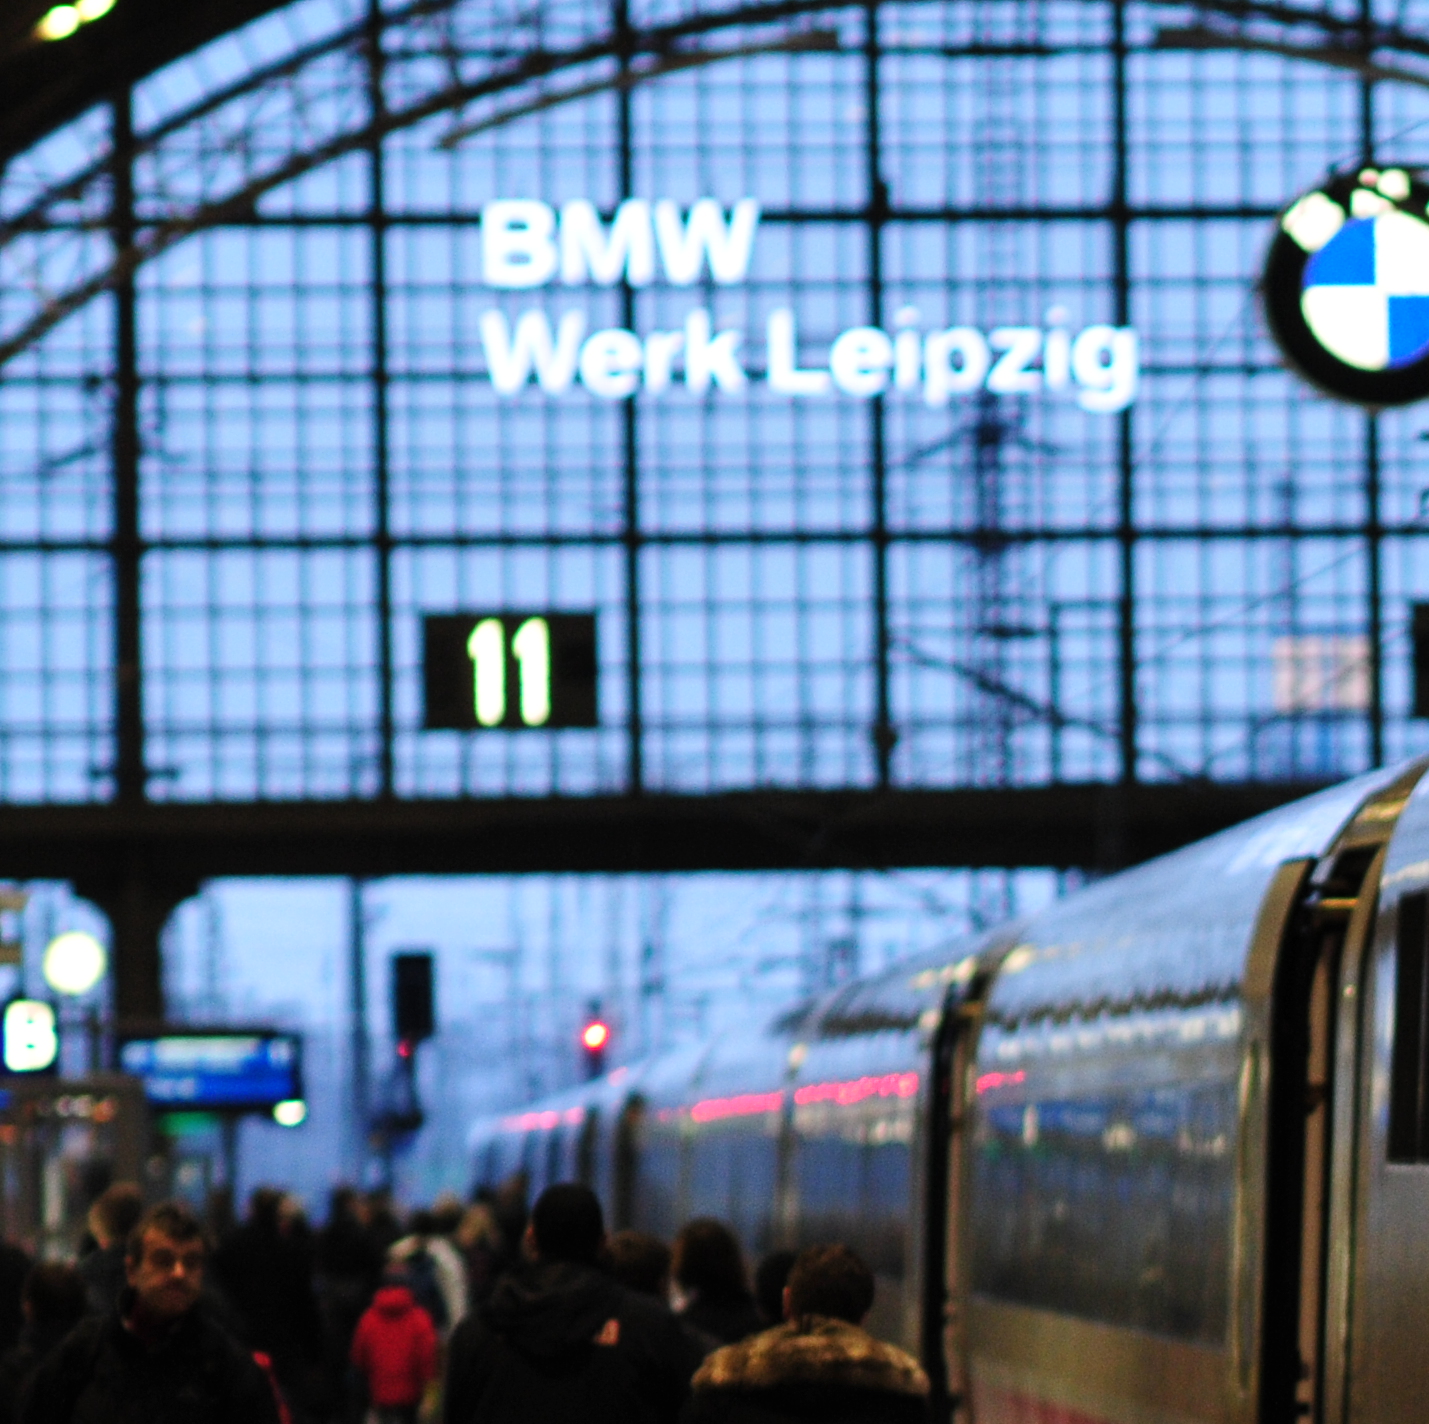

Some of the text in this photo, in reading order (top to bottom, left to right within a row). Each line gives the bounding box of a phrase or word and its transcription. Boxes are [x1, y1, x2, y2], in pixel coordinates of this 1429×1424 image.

[480, 198, 758, 287] BMW
[480, 305, 1138, 412] Werk Leipzig
[467, 617, 551, 727] 11
